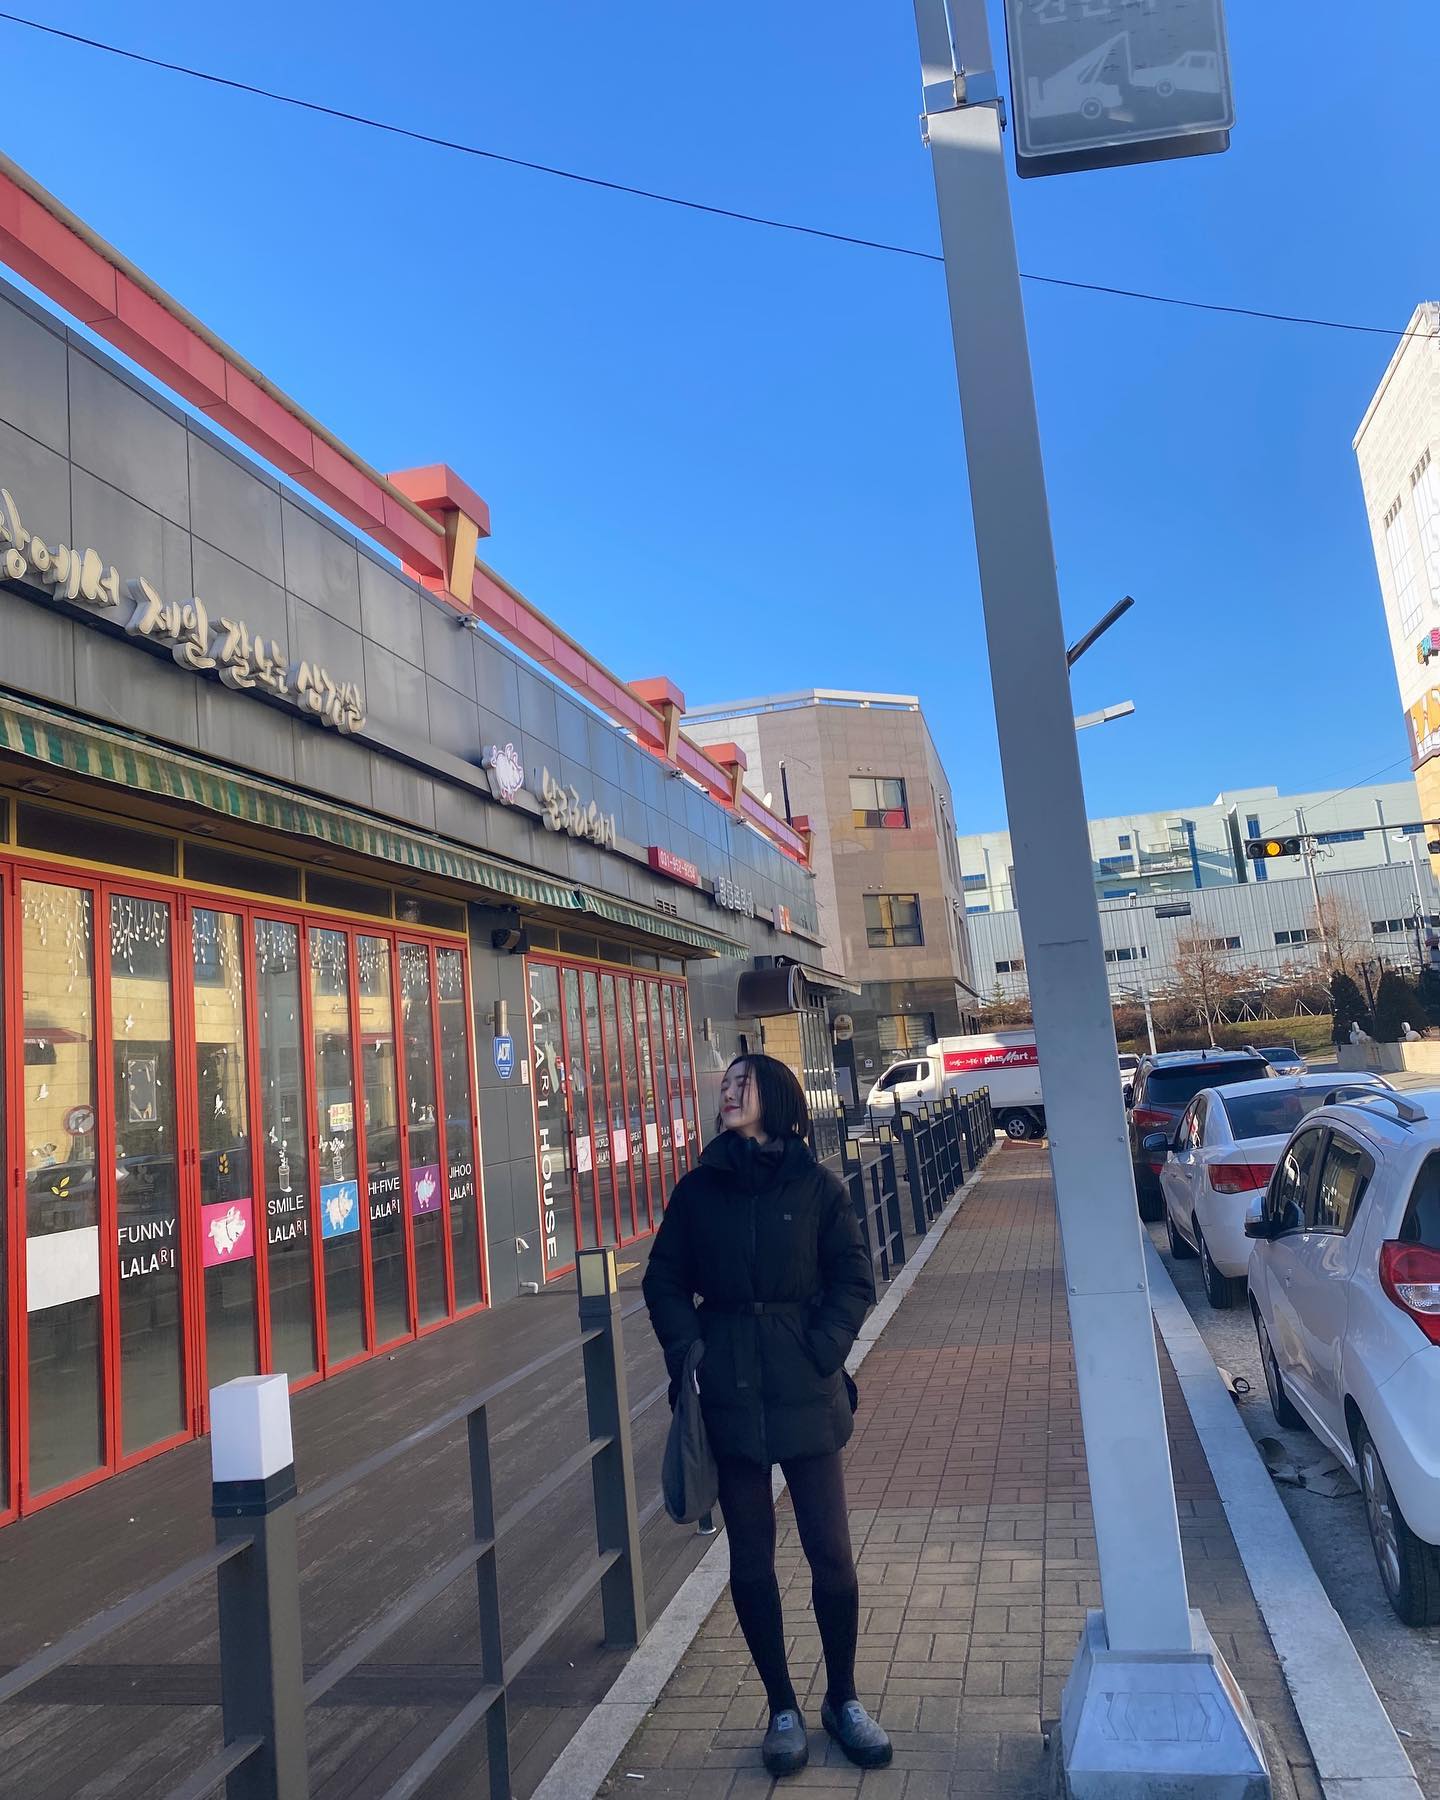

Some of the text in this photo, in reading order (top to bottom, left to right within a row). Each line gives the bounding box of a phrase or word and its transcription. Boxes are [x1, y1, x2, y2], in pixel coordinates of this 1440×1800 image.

[138, 576, 217, 669] 제일
[297, 660, 367, 733] 삼겹살
[497, 1043, 511, 1061] ADT
[448, 1163, 472, 1180] JIHOO
[367, 1176, 401, 1197] HI-FIVE
[540, 1128, 558, 1261] HOUSE
[267, 1194, 305, 1216] SMILE
[117, 1218, 176, 1246] FUNNY
